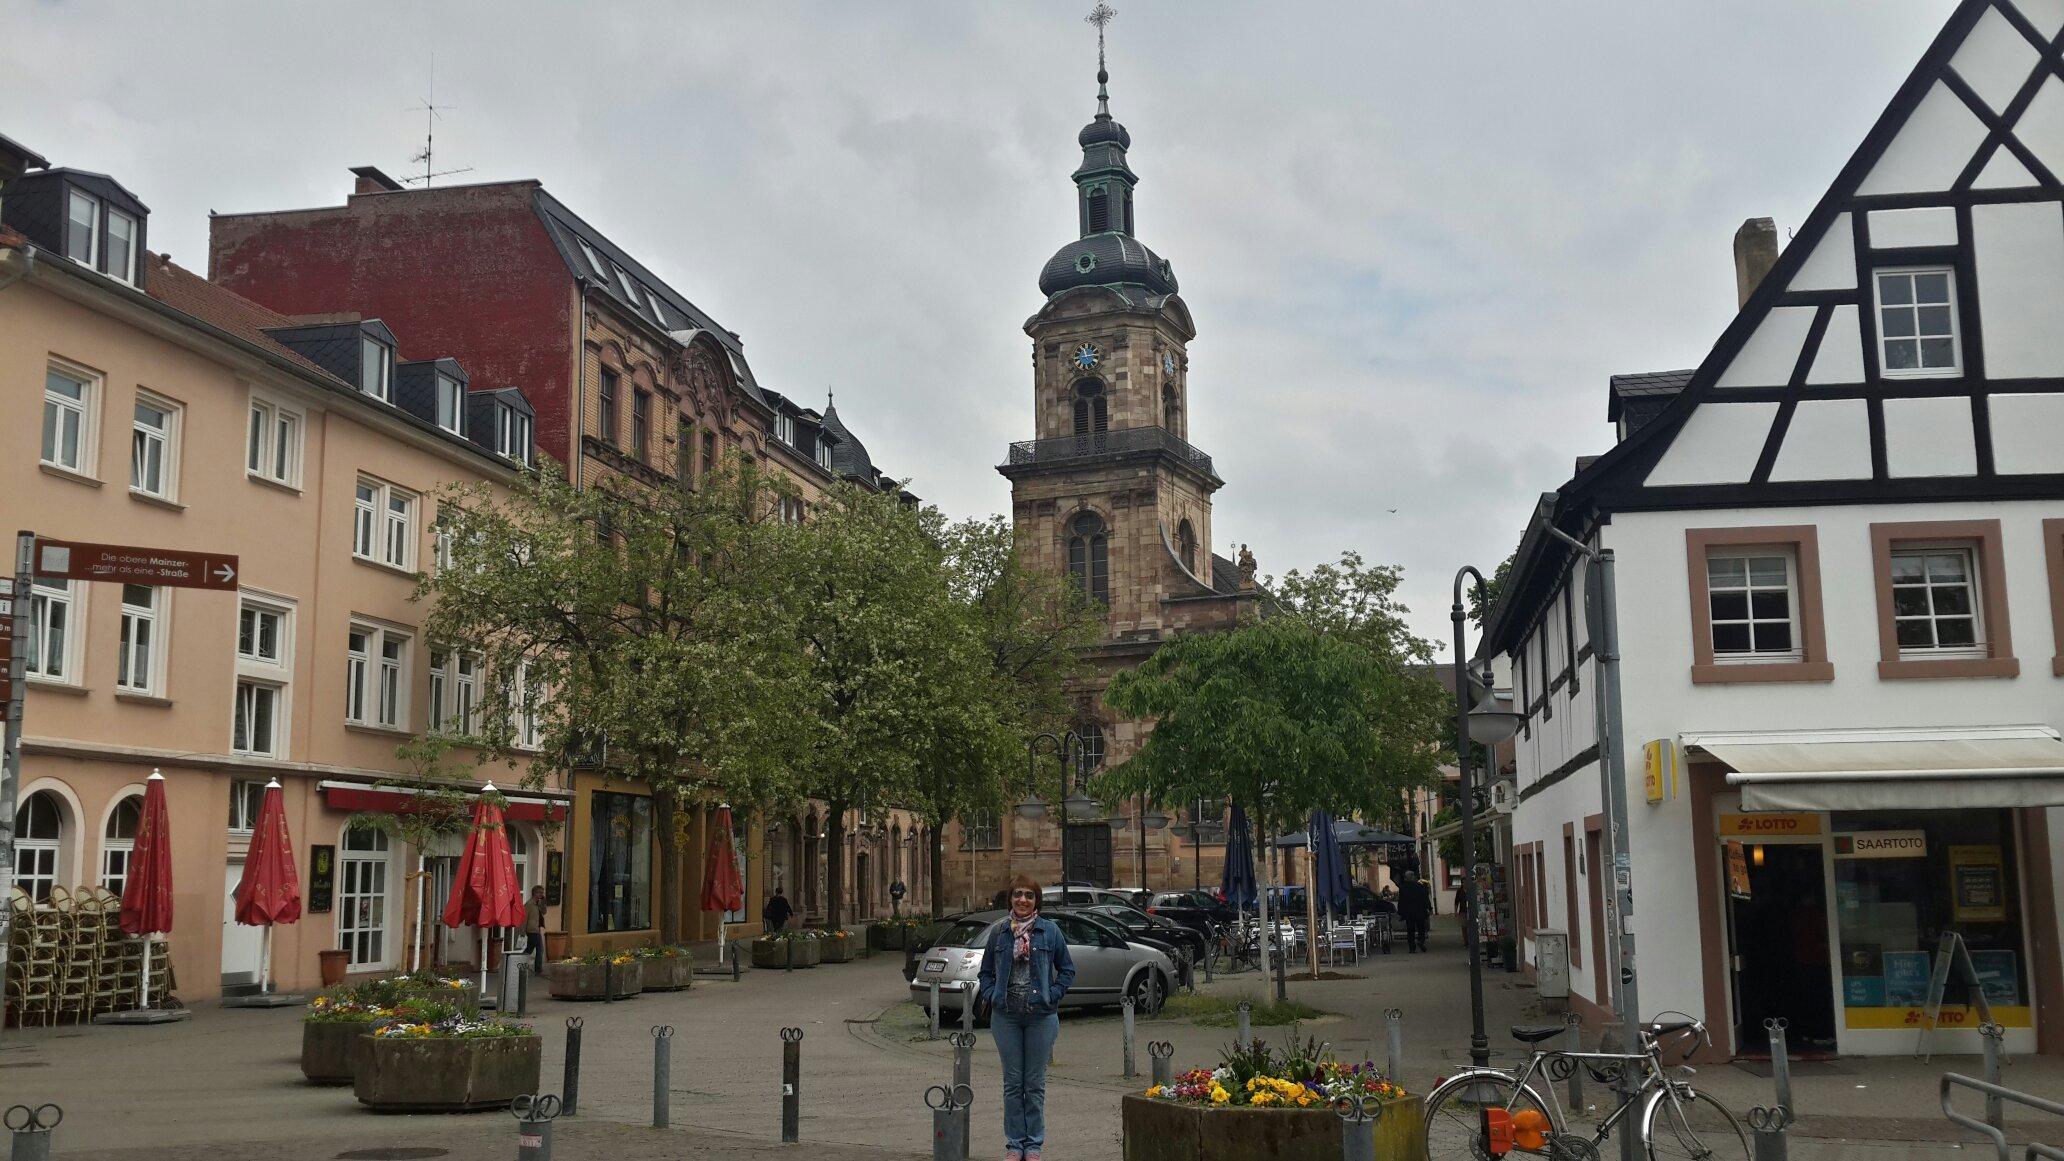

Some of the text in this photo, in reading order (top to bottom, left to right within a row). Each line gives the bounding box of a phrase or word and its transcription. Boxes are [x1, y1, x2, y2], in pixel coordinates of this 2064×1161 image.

[101, 552, 189, 567] Die obere Mainzer-
[133, 566, 154, 575] eine
[157, 568, 189, 578] -Straße
[1755, 818, 1797, 830] LOTTO
[1856, 837, 1923, 850] SAARTOTO
